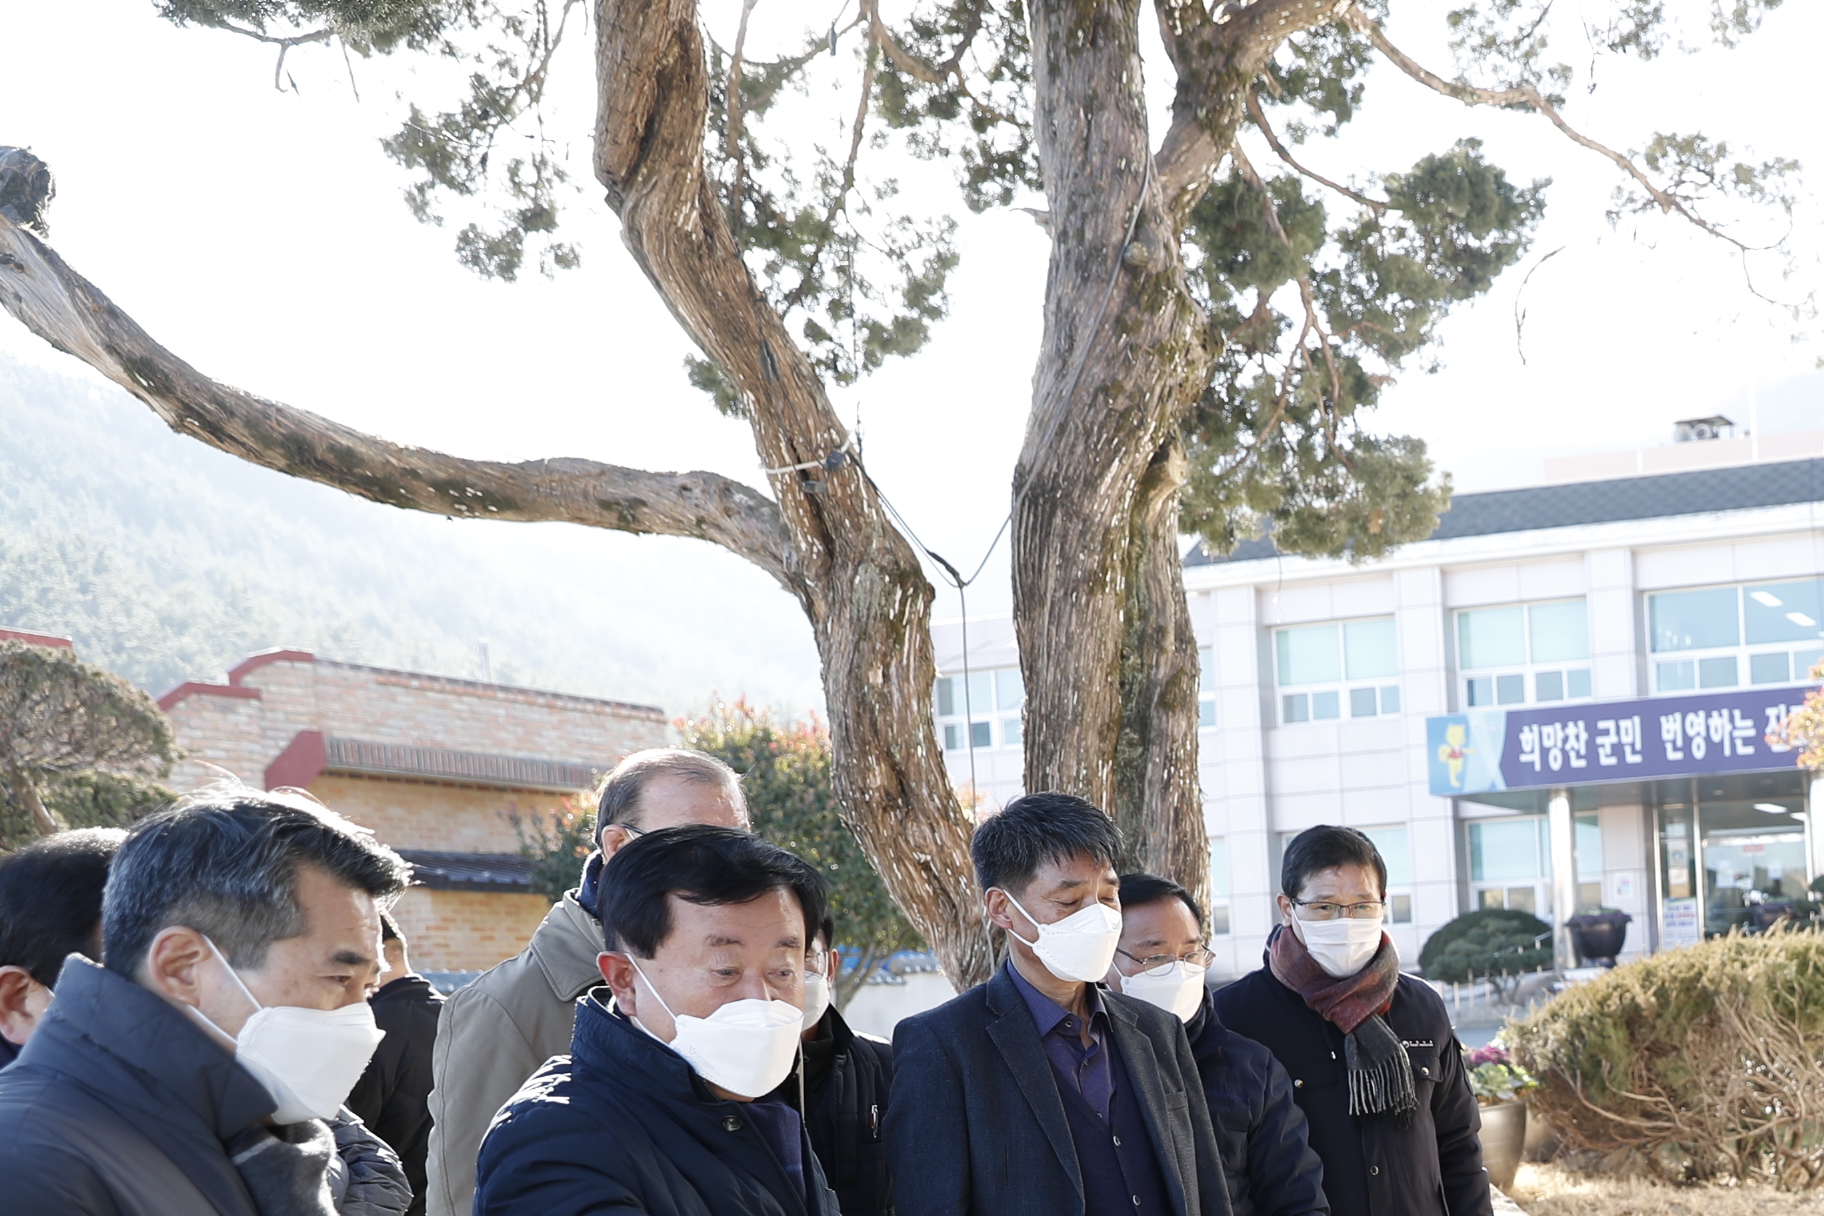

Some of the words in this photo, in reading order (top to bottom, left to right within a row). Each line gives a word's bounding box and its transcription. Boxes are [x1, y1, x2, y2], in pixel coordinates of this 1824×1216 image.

[1518, 720, 1588, 773] 희망찬
[1595, 715, 1643, 767] 군민
[1660, 708, 1757, 762] 번영하는
